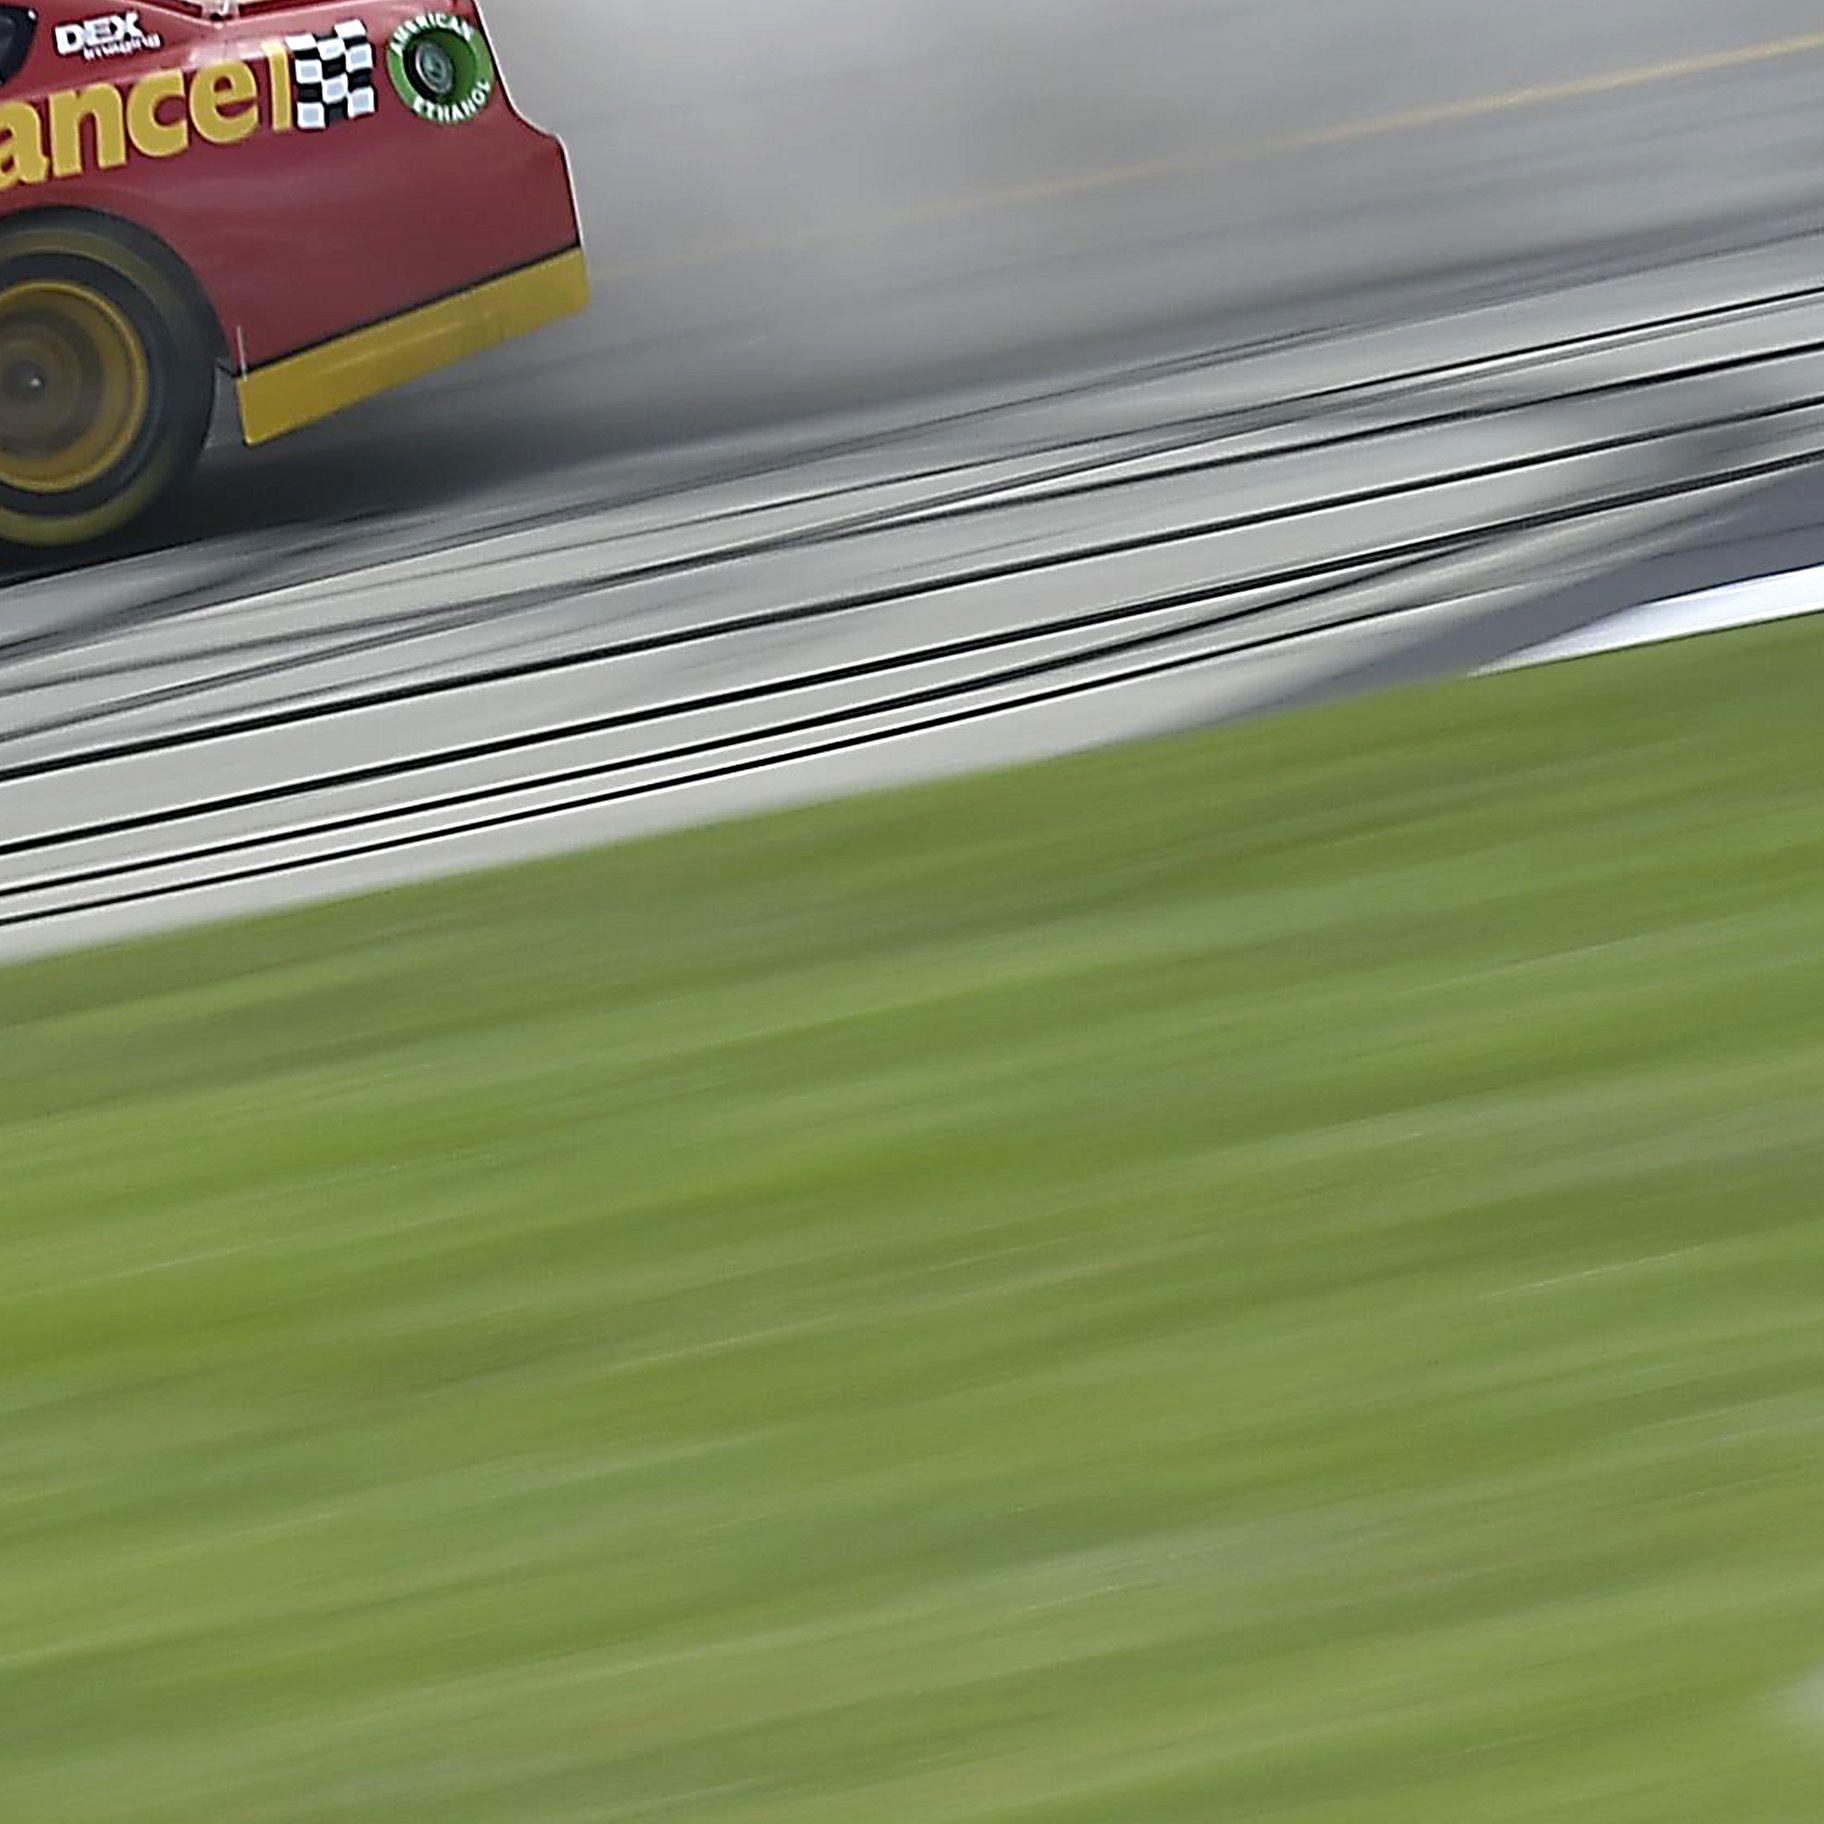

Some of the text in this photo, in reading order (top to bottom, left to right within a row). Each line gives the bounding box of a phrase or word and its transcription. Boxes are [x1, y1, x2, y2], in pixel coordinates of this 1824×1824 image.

[54, 13, 140, 55] DEX
[391, 13, 473, 54] AMERICAN
[413, 77, 489, 124] ETHANOL
